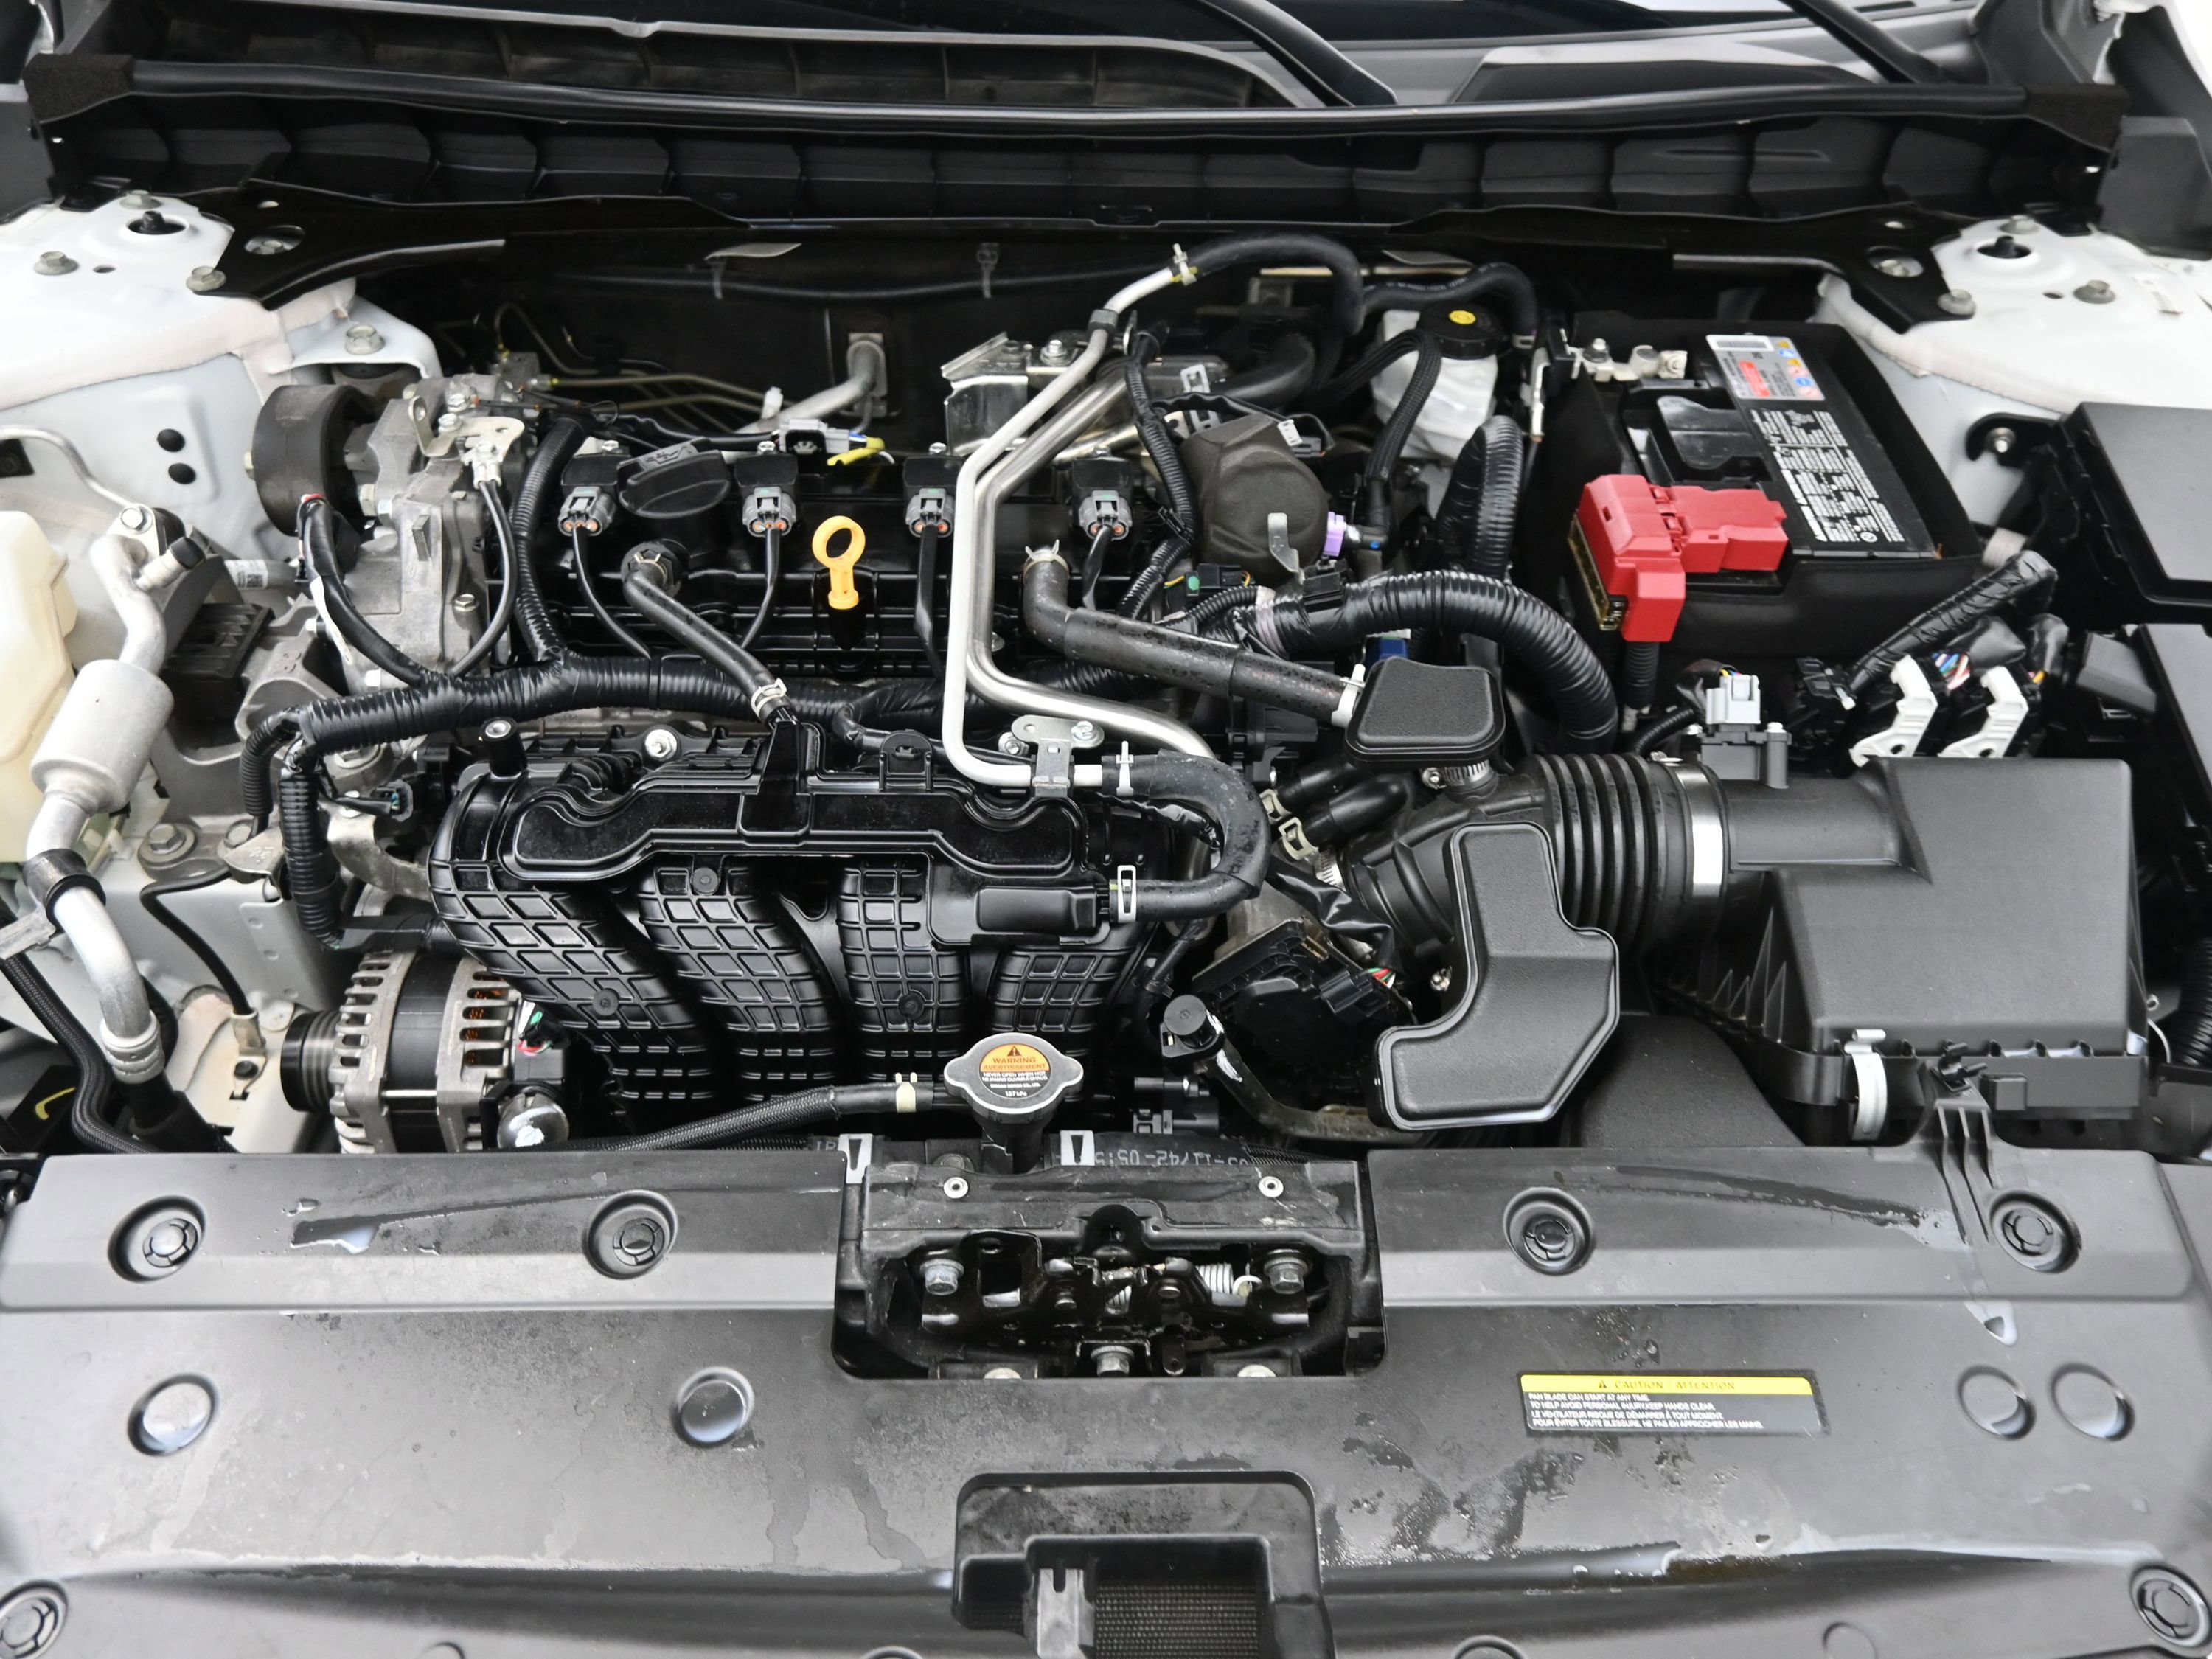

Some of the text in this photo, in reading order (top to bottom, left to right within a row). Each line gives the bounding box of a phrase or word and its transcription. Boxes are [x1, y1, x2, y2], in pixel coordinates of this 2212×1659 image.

[1615, 1380, 1663, 1388] CAUTION
[1676, 1382, 1735, 1390] ATTENTION
[1528, 1392, 1543, 1400] FAN
[1568, 1393, 1584, 1401] CAN
[1585, 1393, 1606, 1401] START
[1543, 1401, 1559, 1409] HELP
[1582, 1402, 1621, 1410] PERSONAL
[1665, 1402, 1690, 1411] HANDS
[1588, 1411, 1614, 1419] RISQUE
[1673, 1411, 1691, 1419] TOUT
[1532, 1419, 1554, 1427] POUR
[1554, 1418, 1579, 1427] ÉVITER
[1668, 1420, 1680, 1428] EN
[1680, 1420, 1724, 1428] APPROCHER
